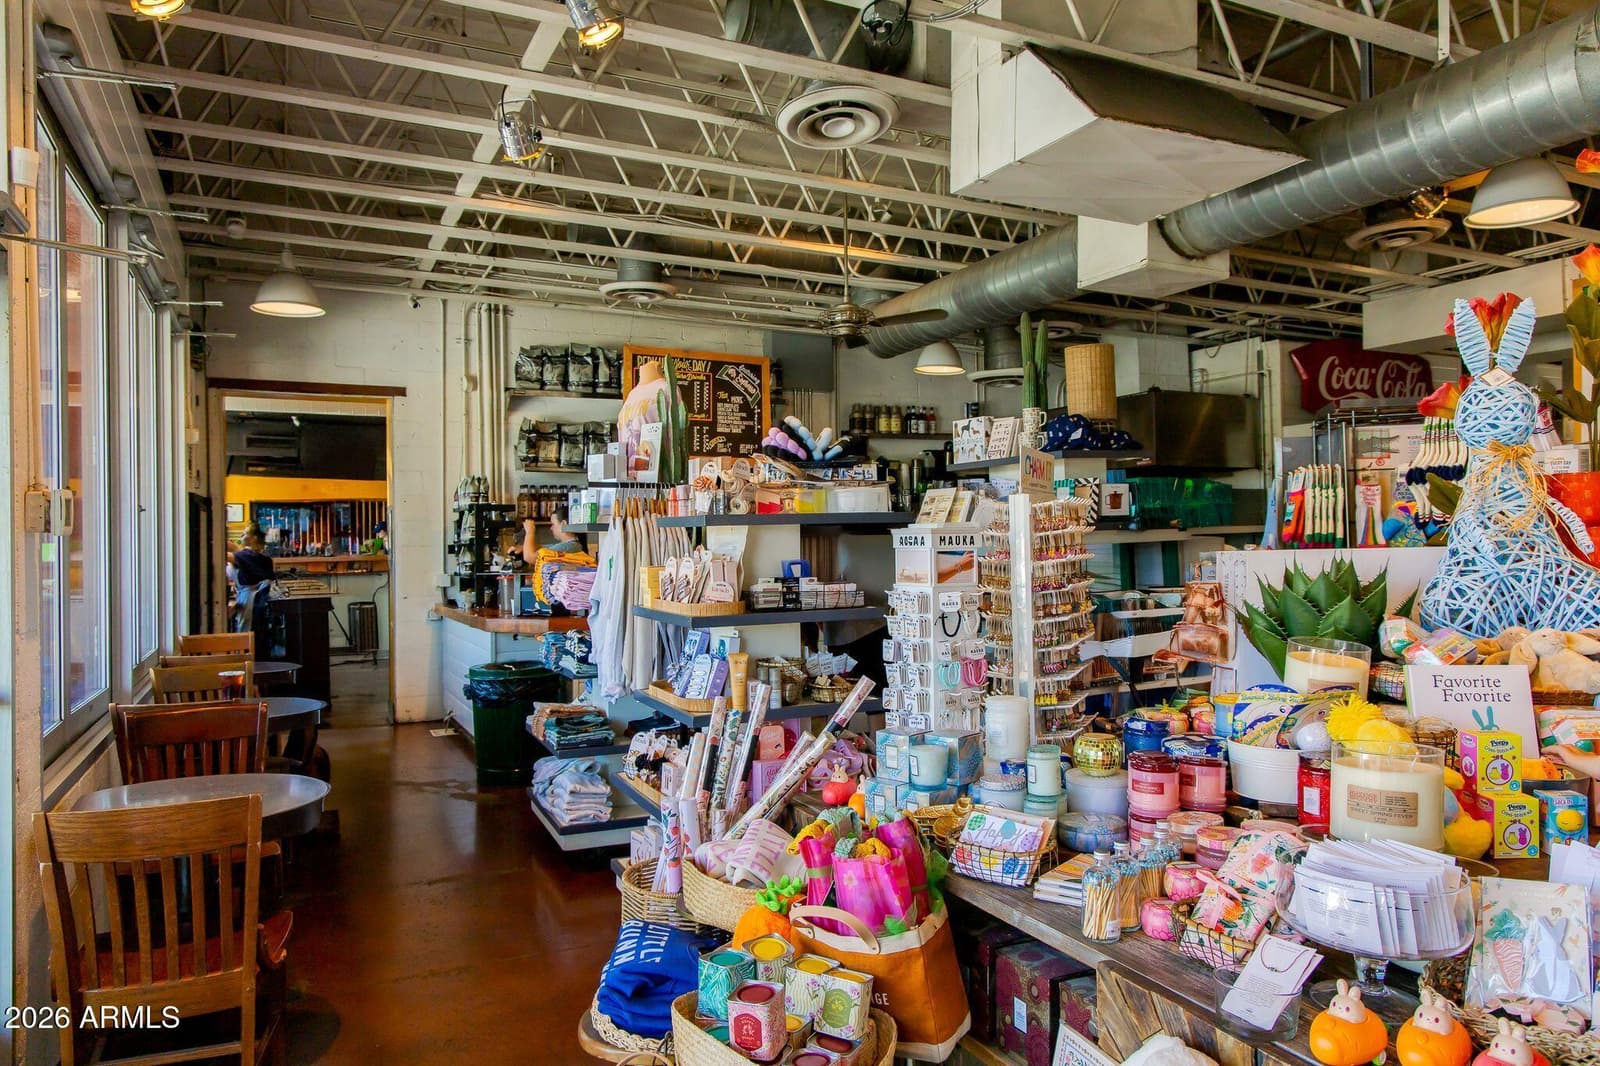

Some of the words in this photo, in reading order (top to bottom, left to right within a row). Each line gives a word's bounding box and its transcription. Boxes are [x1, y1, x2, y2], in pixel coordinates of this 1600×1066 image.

[939, 535, 975, 546] MAUKA
[1432, 674, 1501, 689] Favorite
[1443, 688, 1512, 703] Favorite
[610, 920, 644, 968] BUNN
[872, 992, 890, 1006] GE
